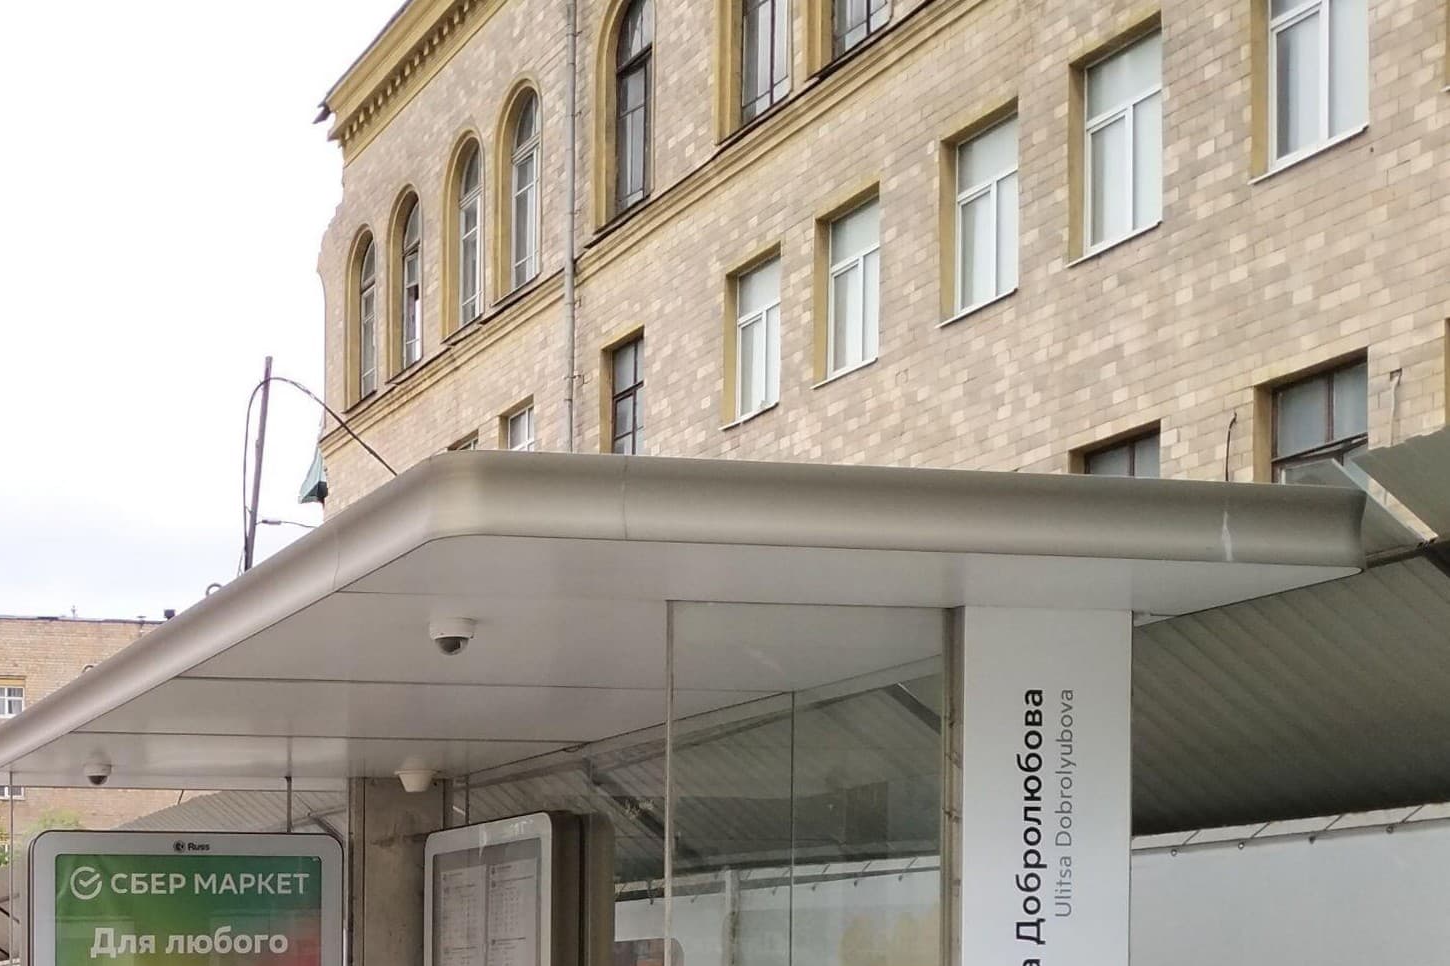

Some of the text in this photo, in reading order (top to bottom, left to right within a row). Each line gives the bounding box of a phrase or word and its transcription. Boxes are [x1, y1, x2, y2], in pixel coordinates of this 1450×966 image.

[1014, 688, 1048, 946] Добролюбова
[1054, 688, 1077, 918] Ulitsa Dobrolyubova
[90, 926, 289, 959] Для любого
[110, 872, 311, 895] СБЕР МАРКЕТ
